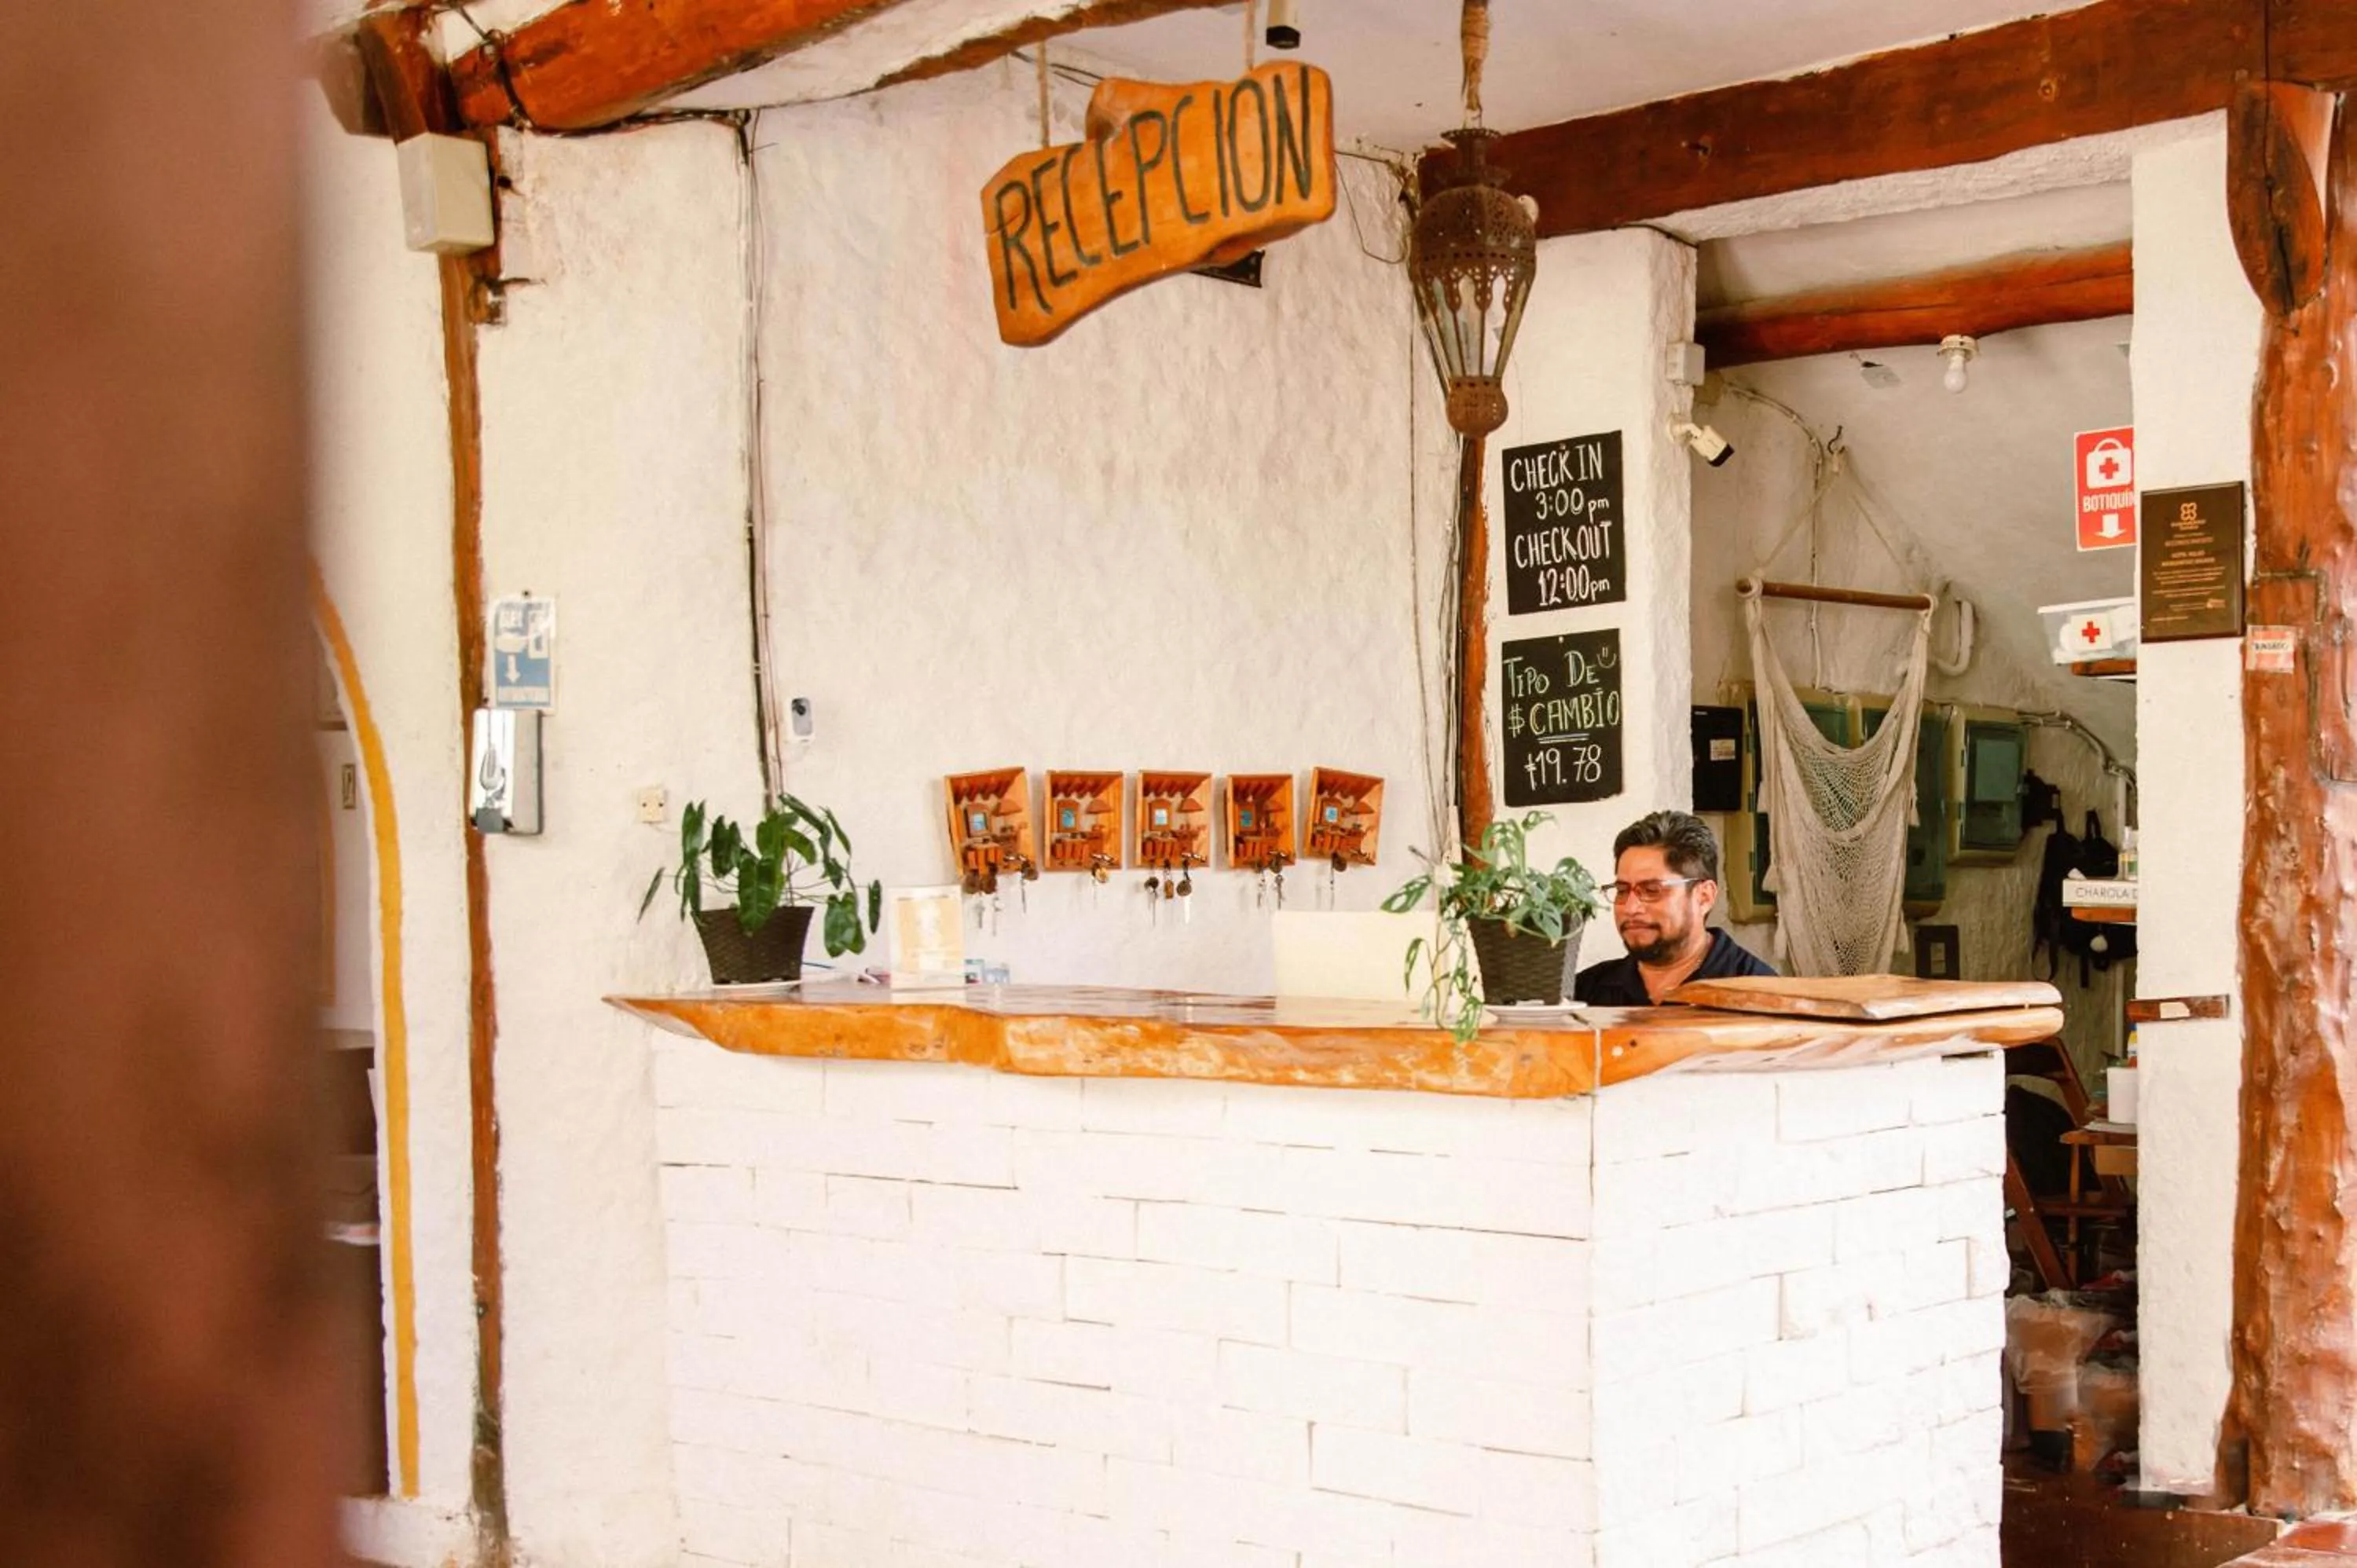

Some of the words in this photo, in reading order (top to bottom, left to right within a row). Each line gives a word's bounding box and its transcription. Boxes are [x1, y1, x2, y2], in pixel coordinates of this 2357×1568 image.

[995, 64, 1312, 316] RECEPCION
[1509, 449, 1574, 493] CHECK
[1575, 441, 1604, 482] IN
[1535, 487, 1584, 520] 3:00
[1588, 497, 1610, 523] pm
